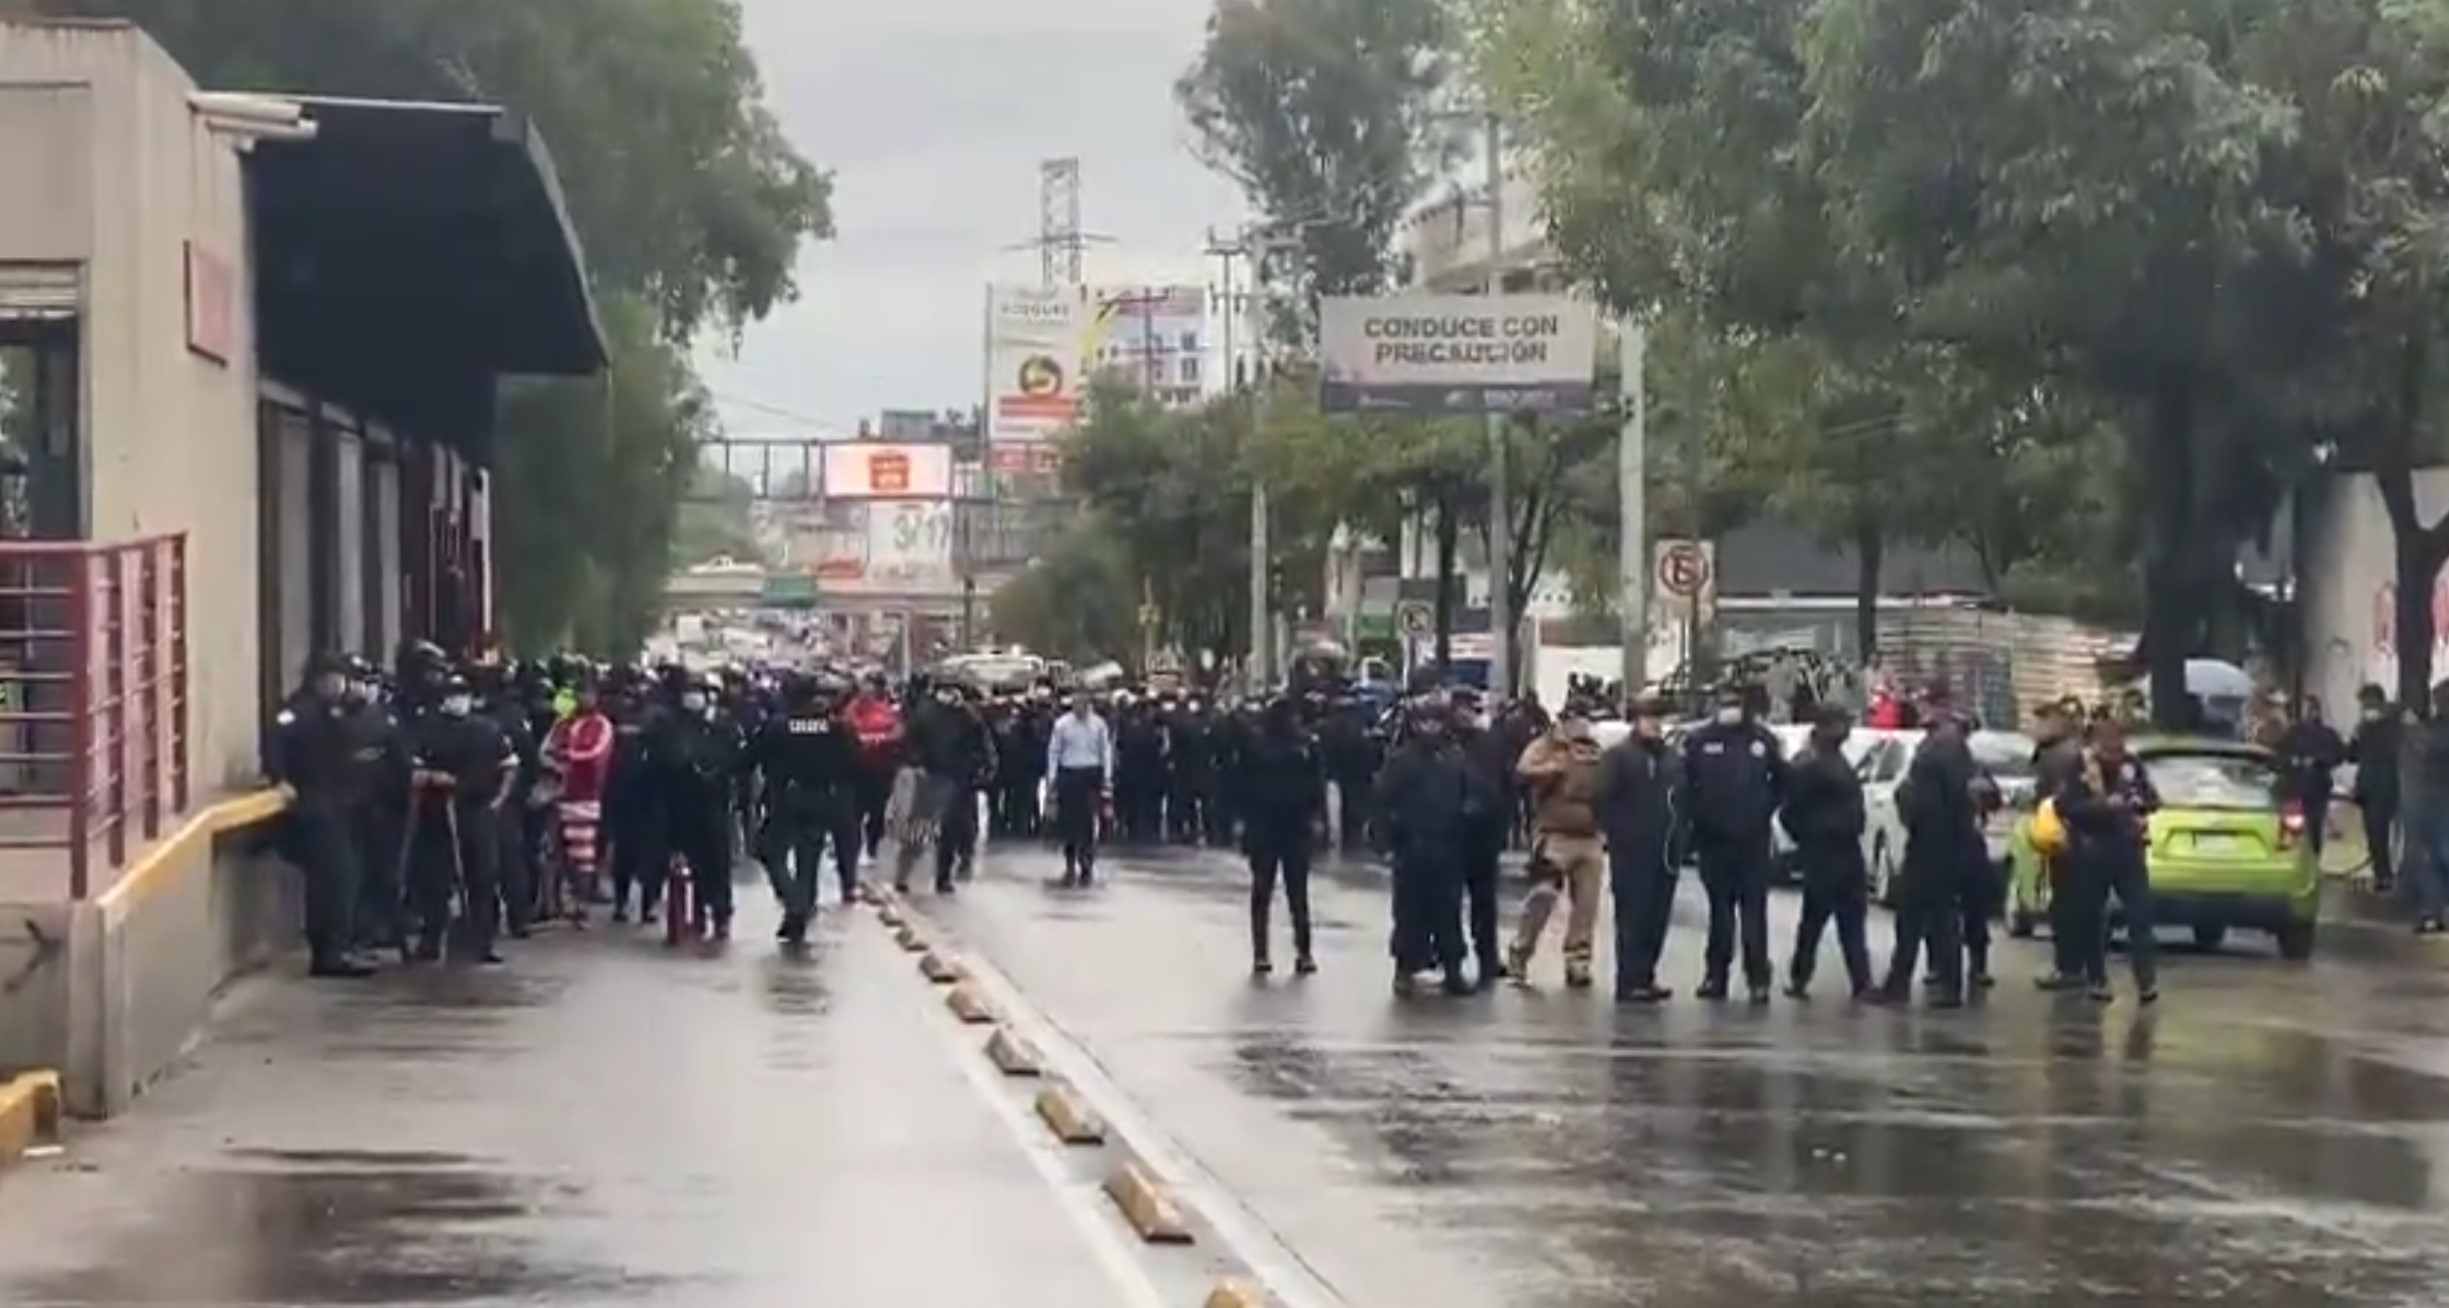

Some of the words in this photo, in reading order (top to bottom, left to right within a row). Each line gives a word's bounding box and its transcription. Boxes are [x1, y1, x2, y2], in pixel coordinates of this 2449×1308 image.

[1364, 317, 1496, 338] CONDUCE
[1502, 316, 1558, 336] CON
[1375, 342, 1548, 363] PRECAUCIÓN
